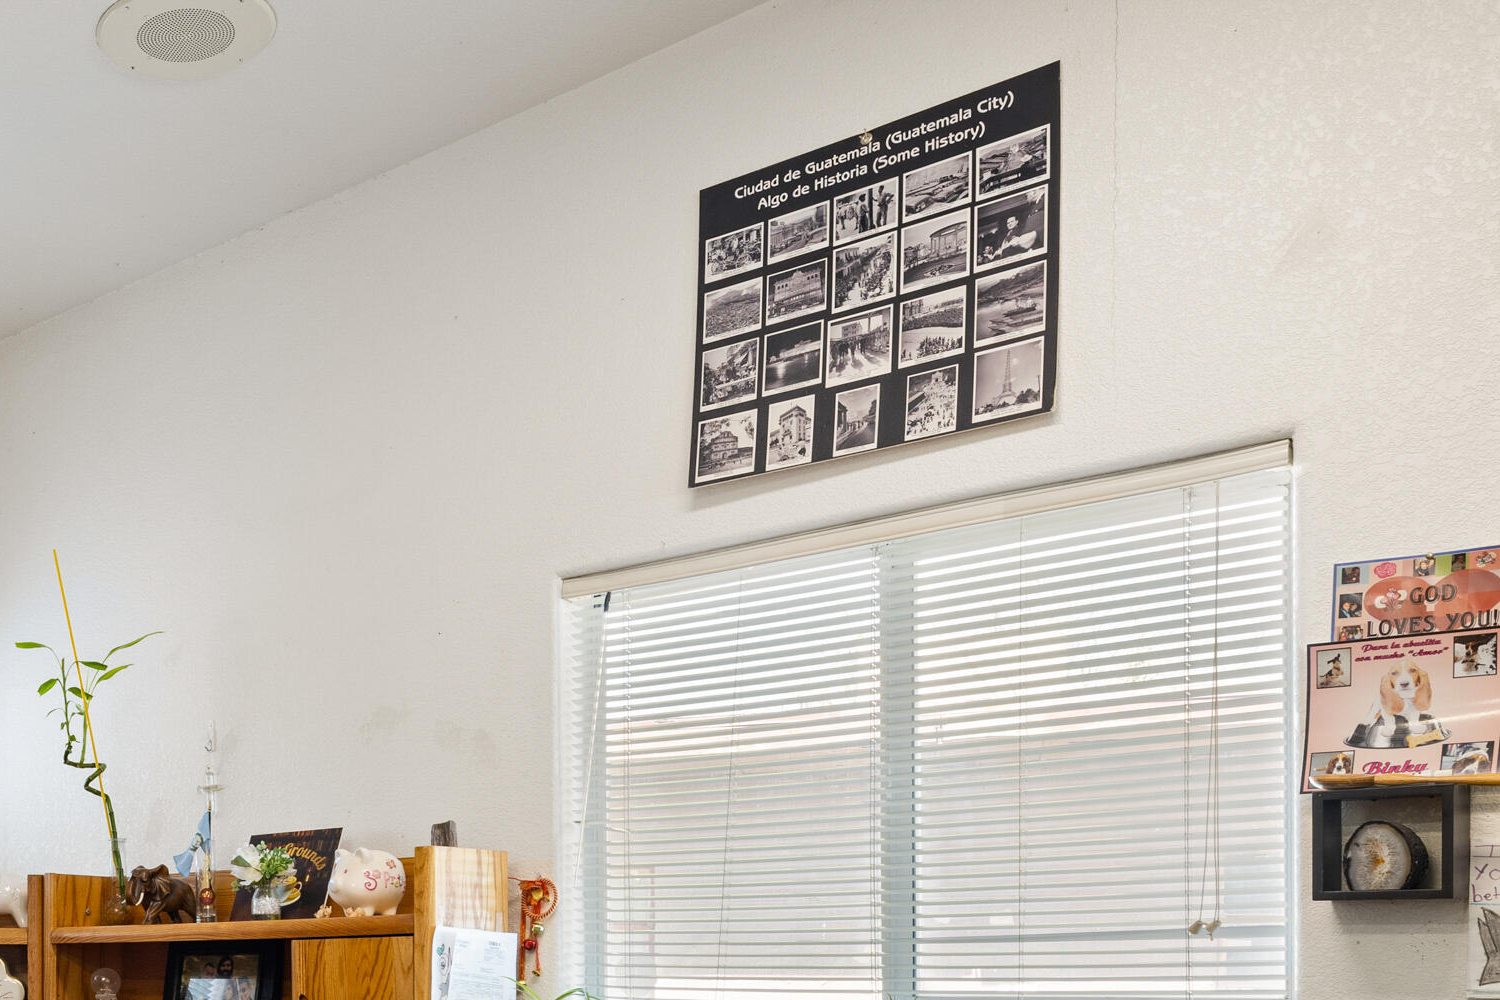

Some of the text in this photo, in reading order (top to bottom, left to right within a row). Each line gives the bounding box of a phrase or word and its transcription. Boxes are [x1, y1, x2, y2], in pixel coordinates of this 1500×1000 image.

[734, 91, 1014, 199] Ciudad de Guatemala (Guatemala City)
[757, 121, 986, 210] Algo de Historia (Some History)
[1410, 584, 1457, 604] GOD
[1367, 608, 1500, 637] LOVES YOU!
[1362, 759, 1429, 774] Binky
[284, 842, 327, 871] Grounds
